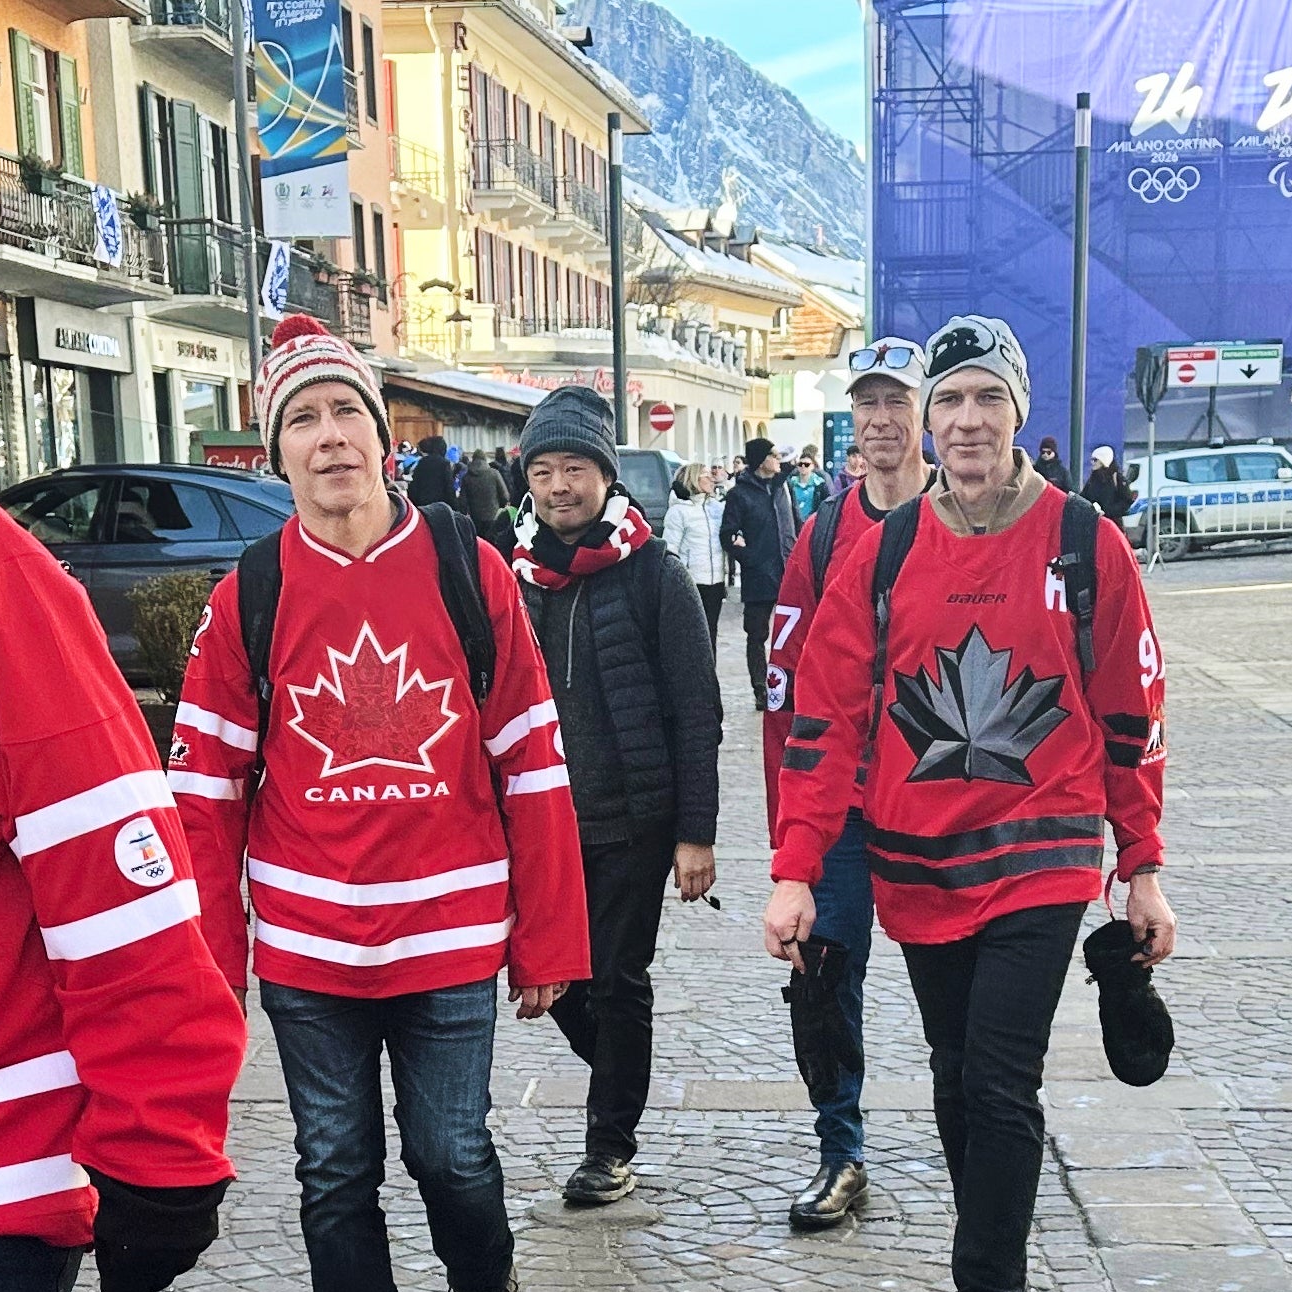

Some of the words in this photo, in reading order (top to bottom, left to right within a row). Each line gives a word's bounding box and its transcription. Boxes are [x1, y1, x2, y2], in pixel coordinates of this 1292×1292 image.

[1106, 140, 1164, 153] MILANO
[1166, 138, 1223, 151] CORTINA
[1234, 134, 1291, 147] MILANO
[1151, 152, 1178, 163] 2026
[773, 604, 802, 650] 7
[305, 781, 450, 802] CANADA
